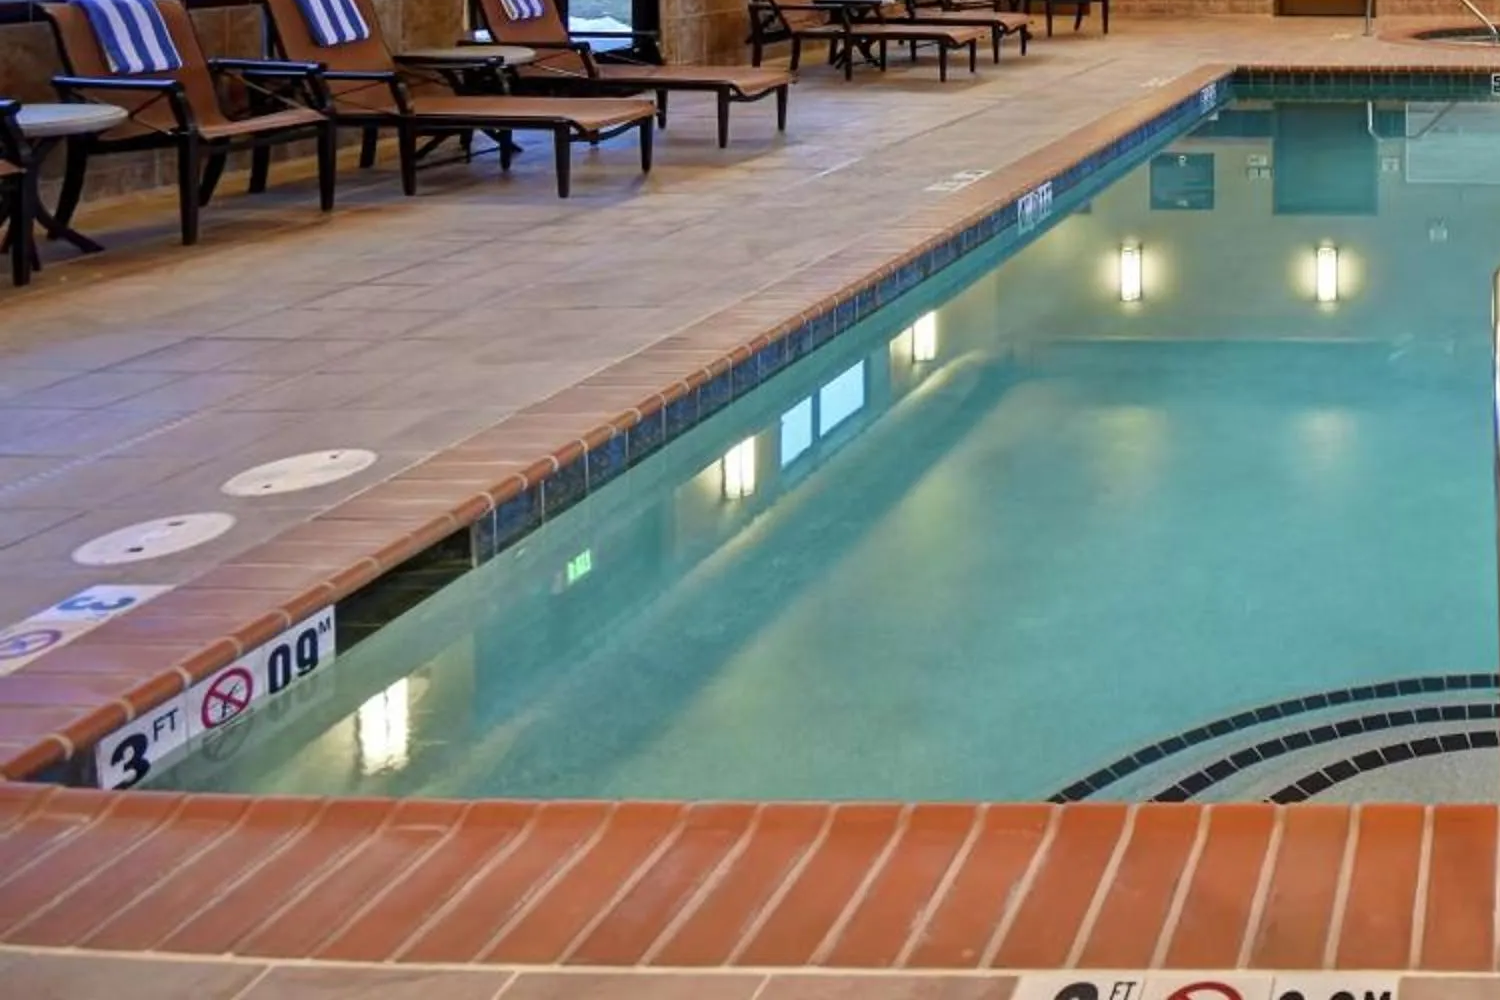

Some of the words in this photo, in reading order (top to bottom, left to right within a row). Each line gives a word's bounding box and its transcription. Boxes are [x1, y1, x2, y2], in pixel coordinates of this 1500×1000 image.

[318, 616, 332, 635] M
[111, 732, 151, 790] 3
[153, 706, 179, 742] FT
[1109, 981, 1137, 1000] FT
